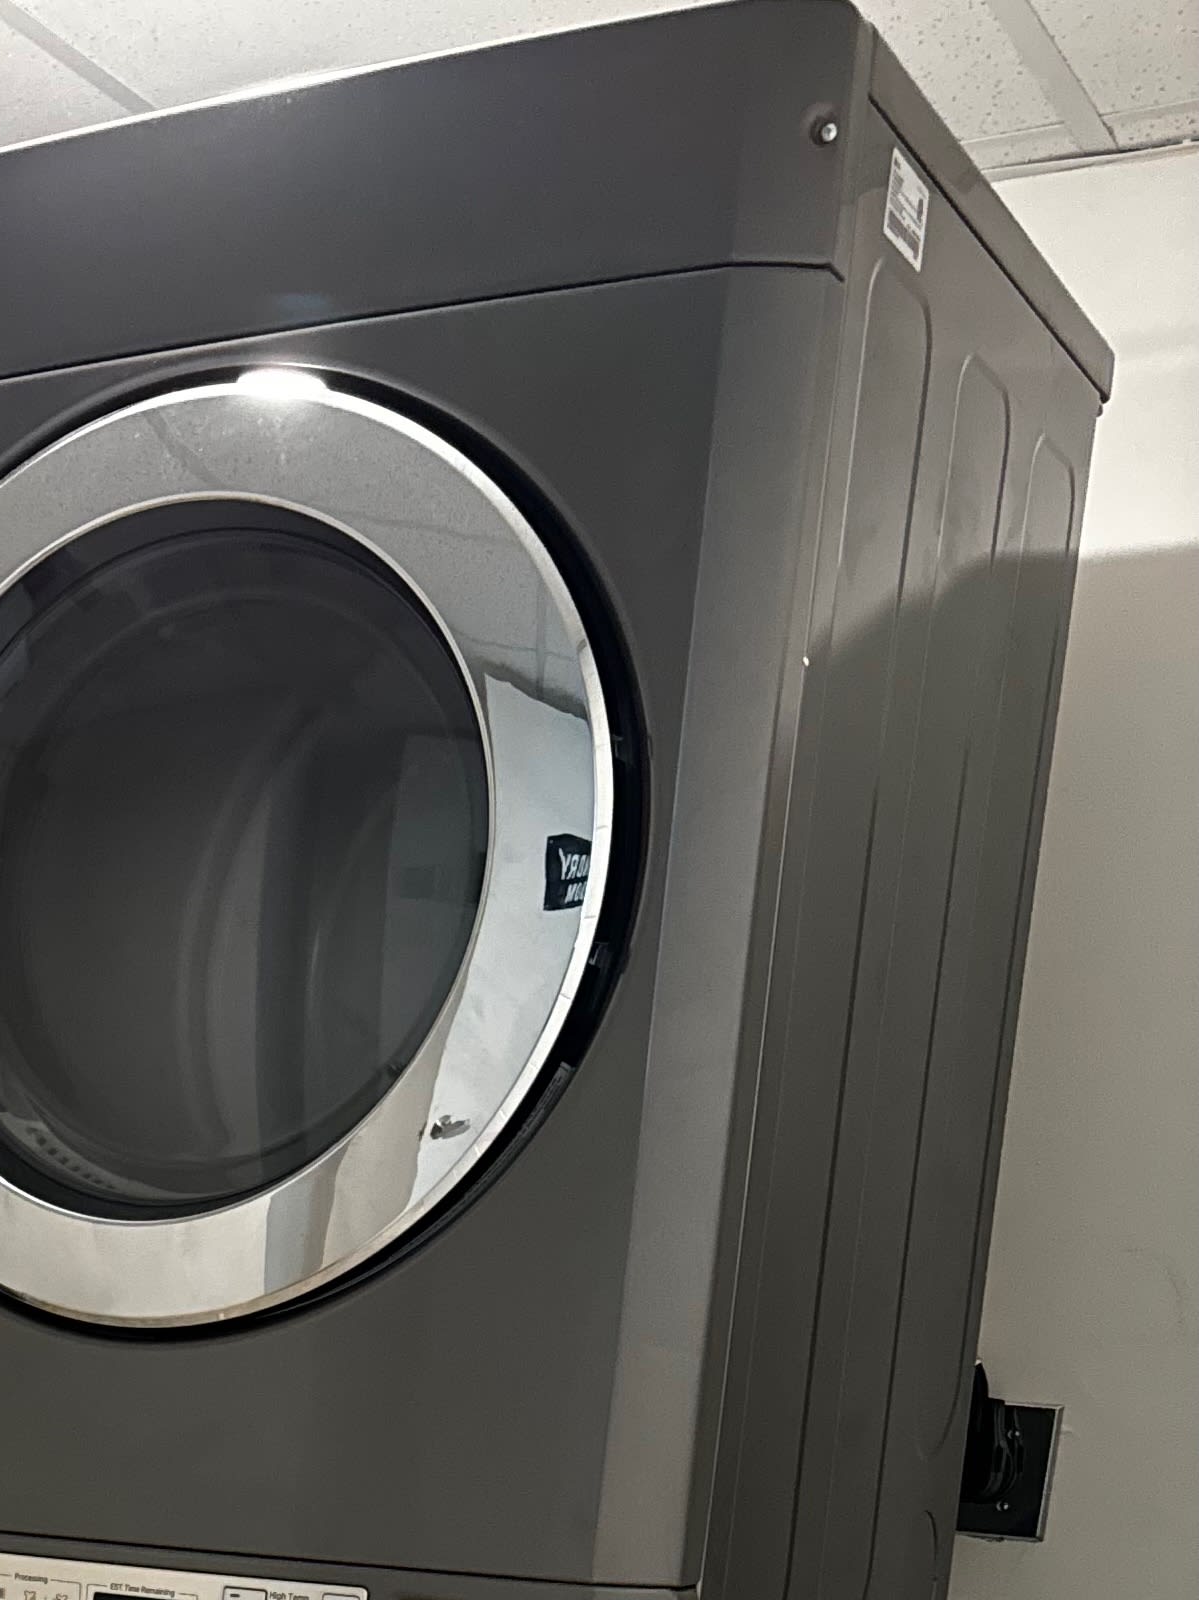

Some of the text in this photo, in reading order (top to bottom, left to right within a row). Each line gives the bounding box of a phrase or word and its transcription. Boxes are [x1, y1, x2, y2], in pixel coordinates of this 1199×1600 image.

[14, 1573, 48, 1585] Processing
[125, 1584, 140, 1593] Time
[141, 1586, 175, 1598] Remaining
